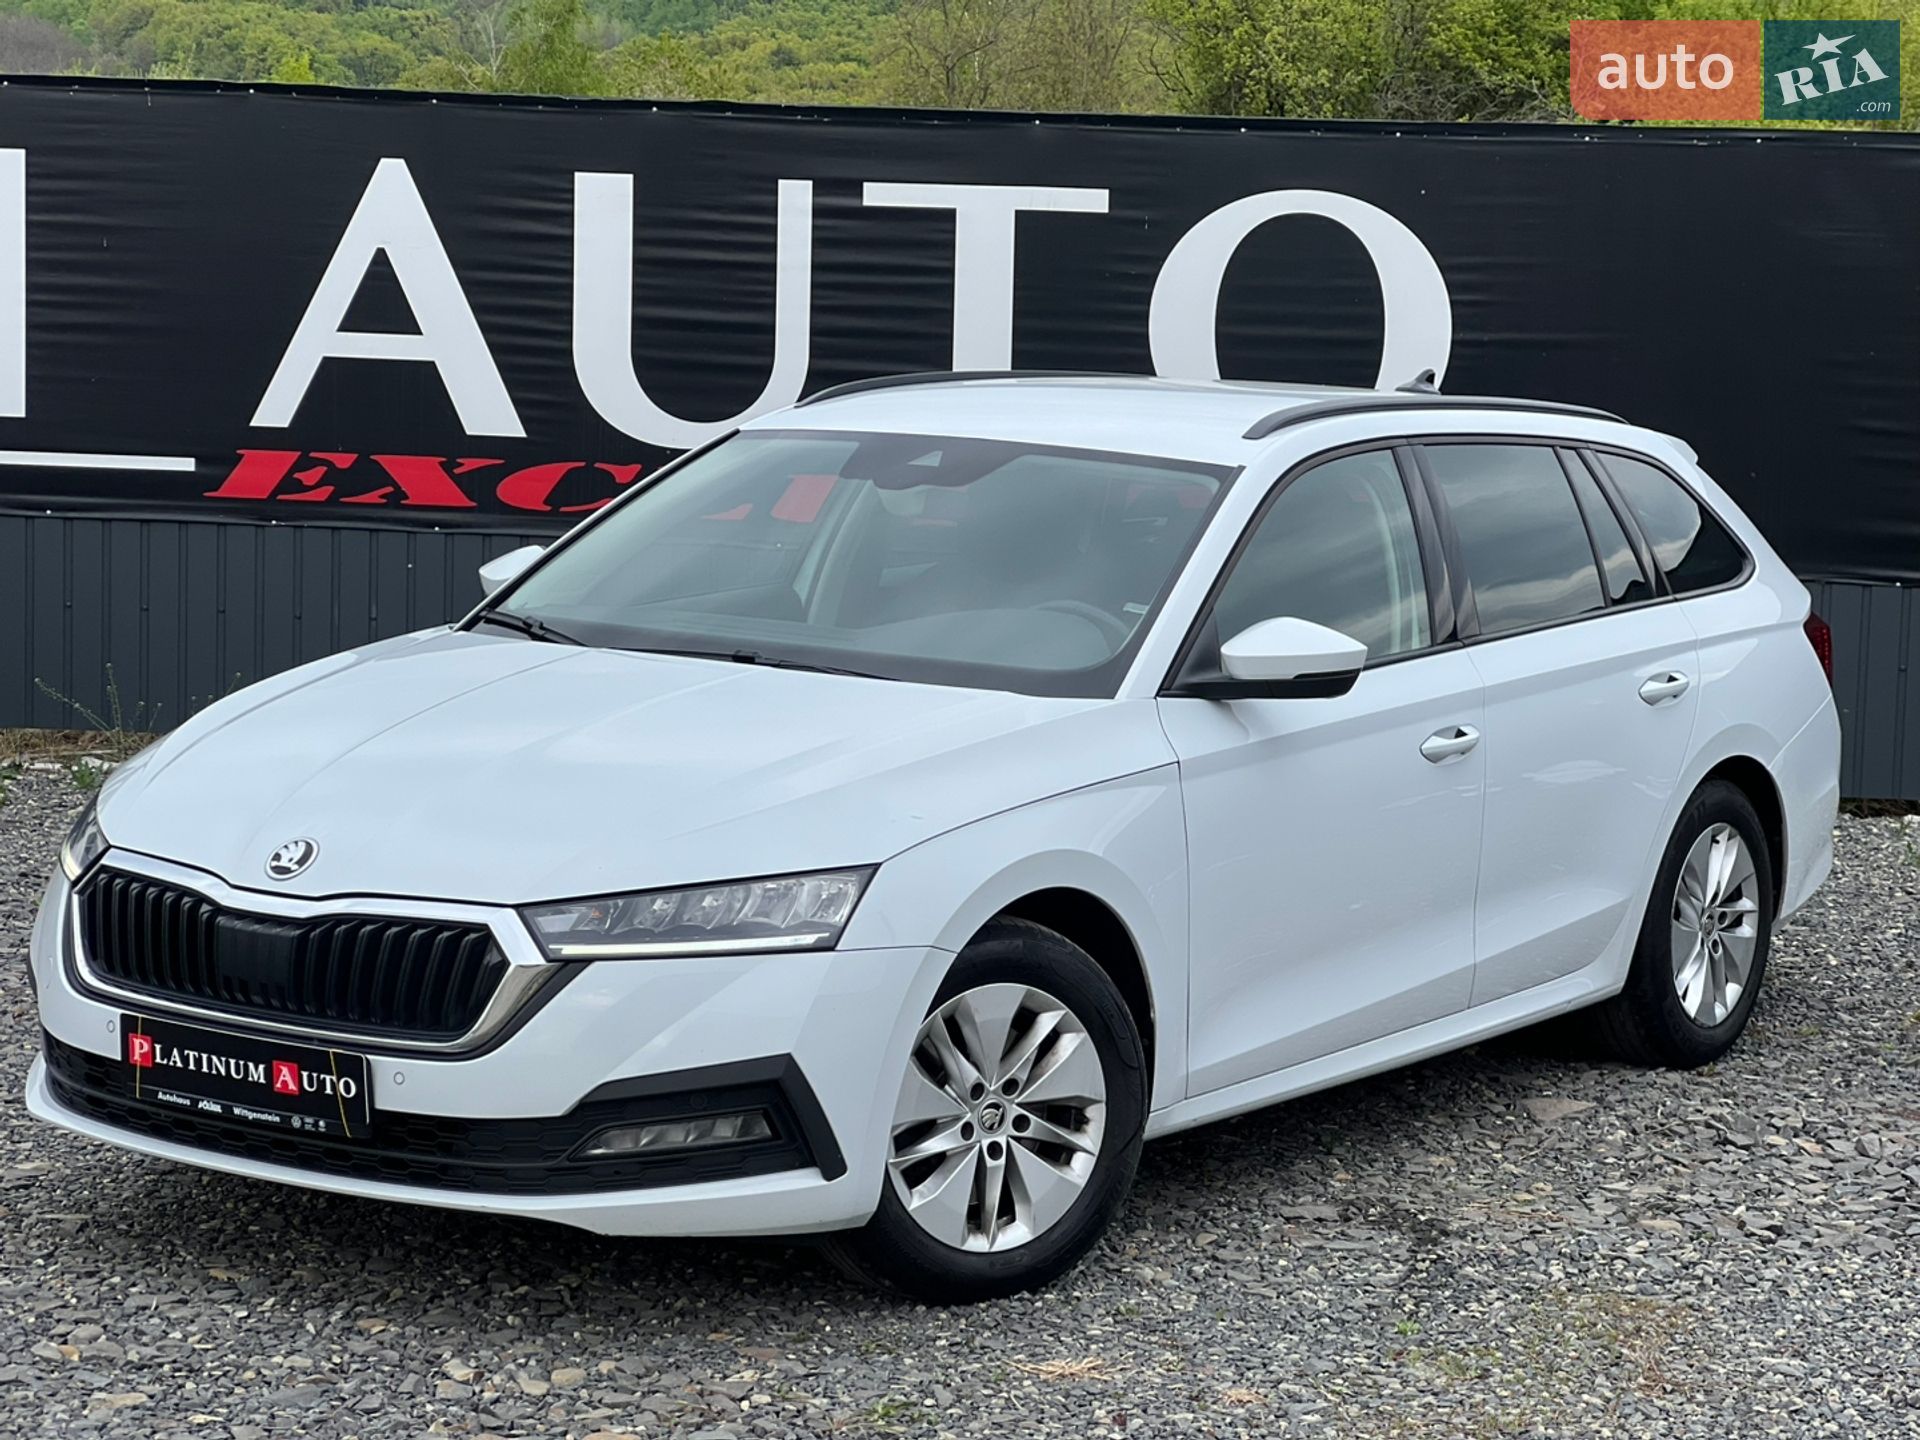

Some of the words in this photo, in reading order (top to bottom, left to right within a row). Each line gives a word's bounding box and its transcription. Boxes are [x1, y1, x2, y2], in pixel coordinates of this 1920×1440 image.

[249, 157, 1453, 450] AUTO
[204, 448, 644, 513] EXC
[130, 1036, 267, 1084] PLATINUM
[275, 1065, 357, 1099] AUTO
[157, 1091, 191, 1106] Autohaus
[233, 1106, 281, 1123] Wittgenstein
